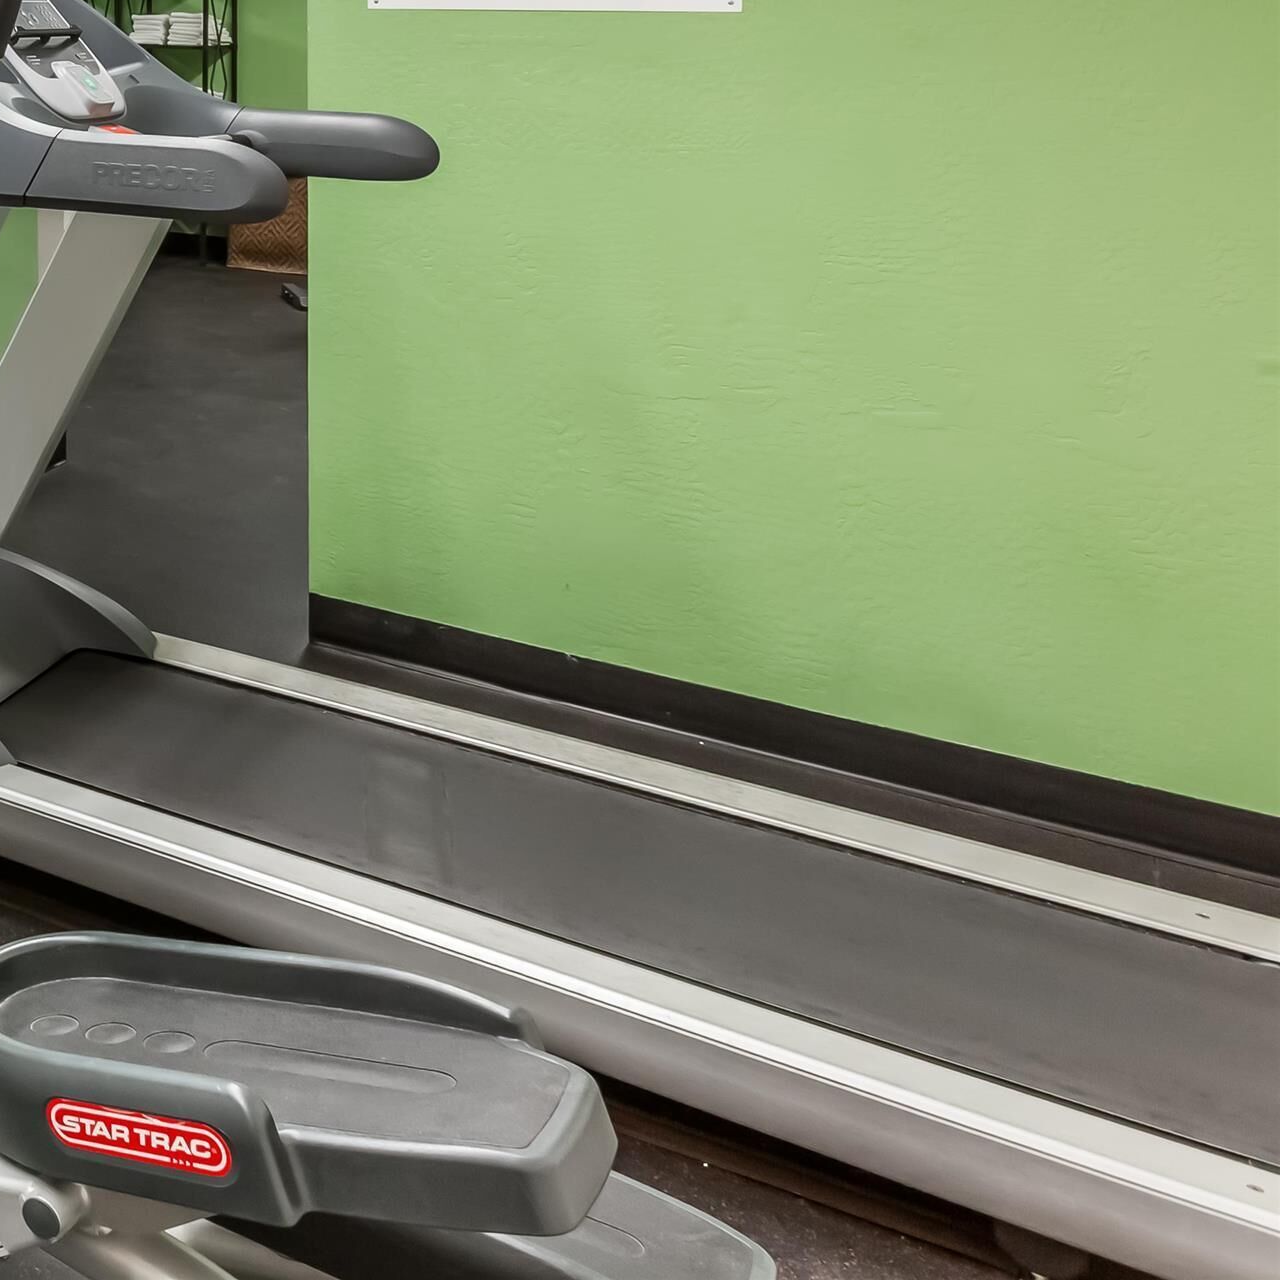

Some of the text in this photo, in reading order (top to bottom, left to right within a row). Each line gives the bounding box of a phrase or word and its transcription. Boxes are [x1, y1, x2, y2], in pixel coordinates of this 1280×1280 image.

[92, 161, 198, 191] PRECOR
[57, 1114, 212, 1159] STAR TRAC
